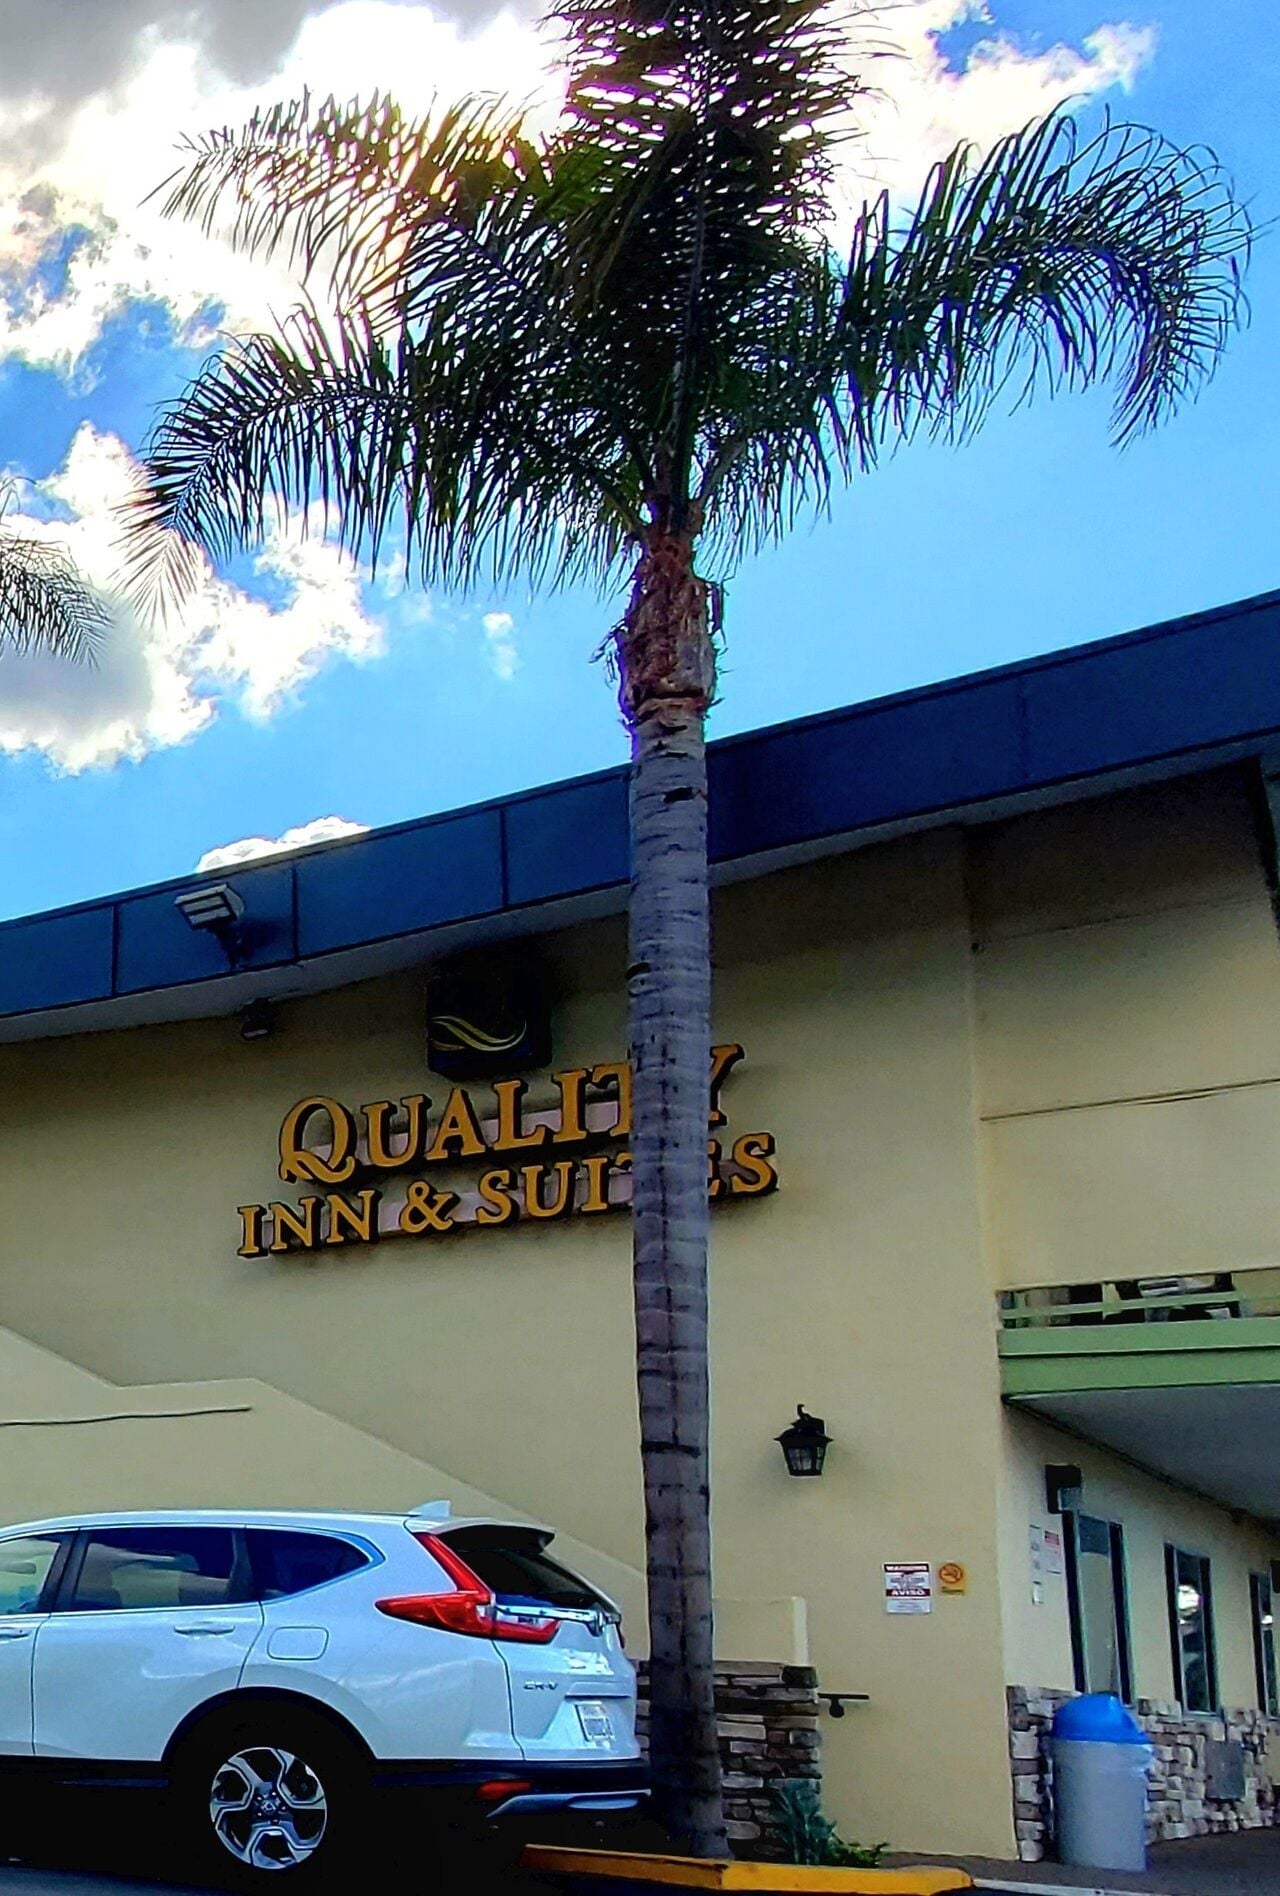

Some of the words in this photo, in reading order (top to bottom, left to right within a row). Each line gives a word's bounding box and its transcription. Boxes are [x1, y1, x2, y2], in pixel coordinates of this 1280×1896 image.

[237, 1189, 382, 1257] INN
[398, 1180, 460, 1234] &
[475, 1132, 778, 1227] SUIS
